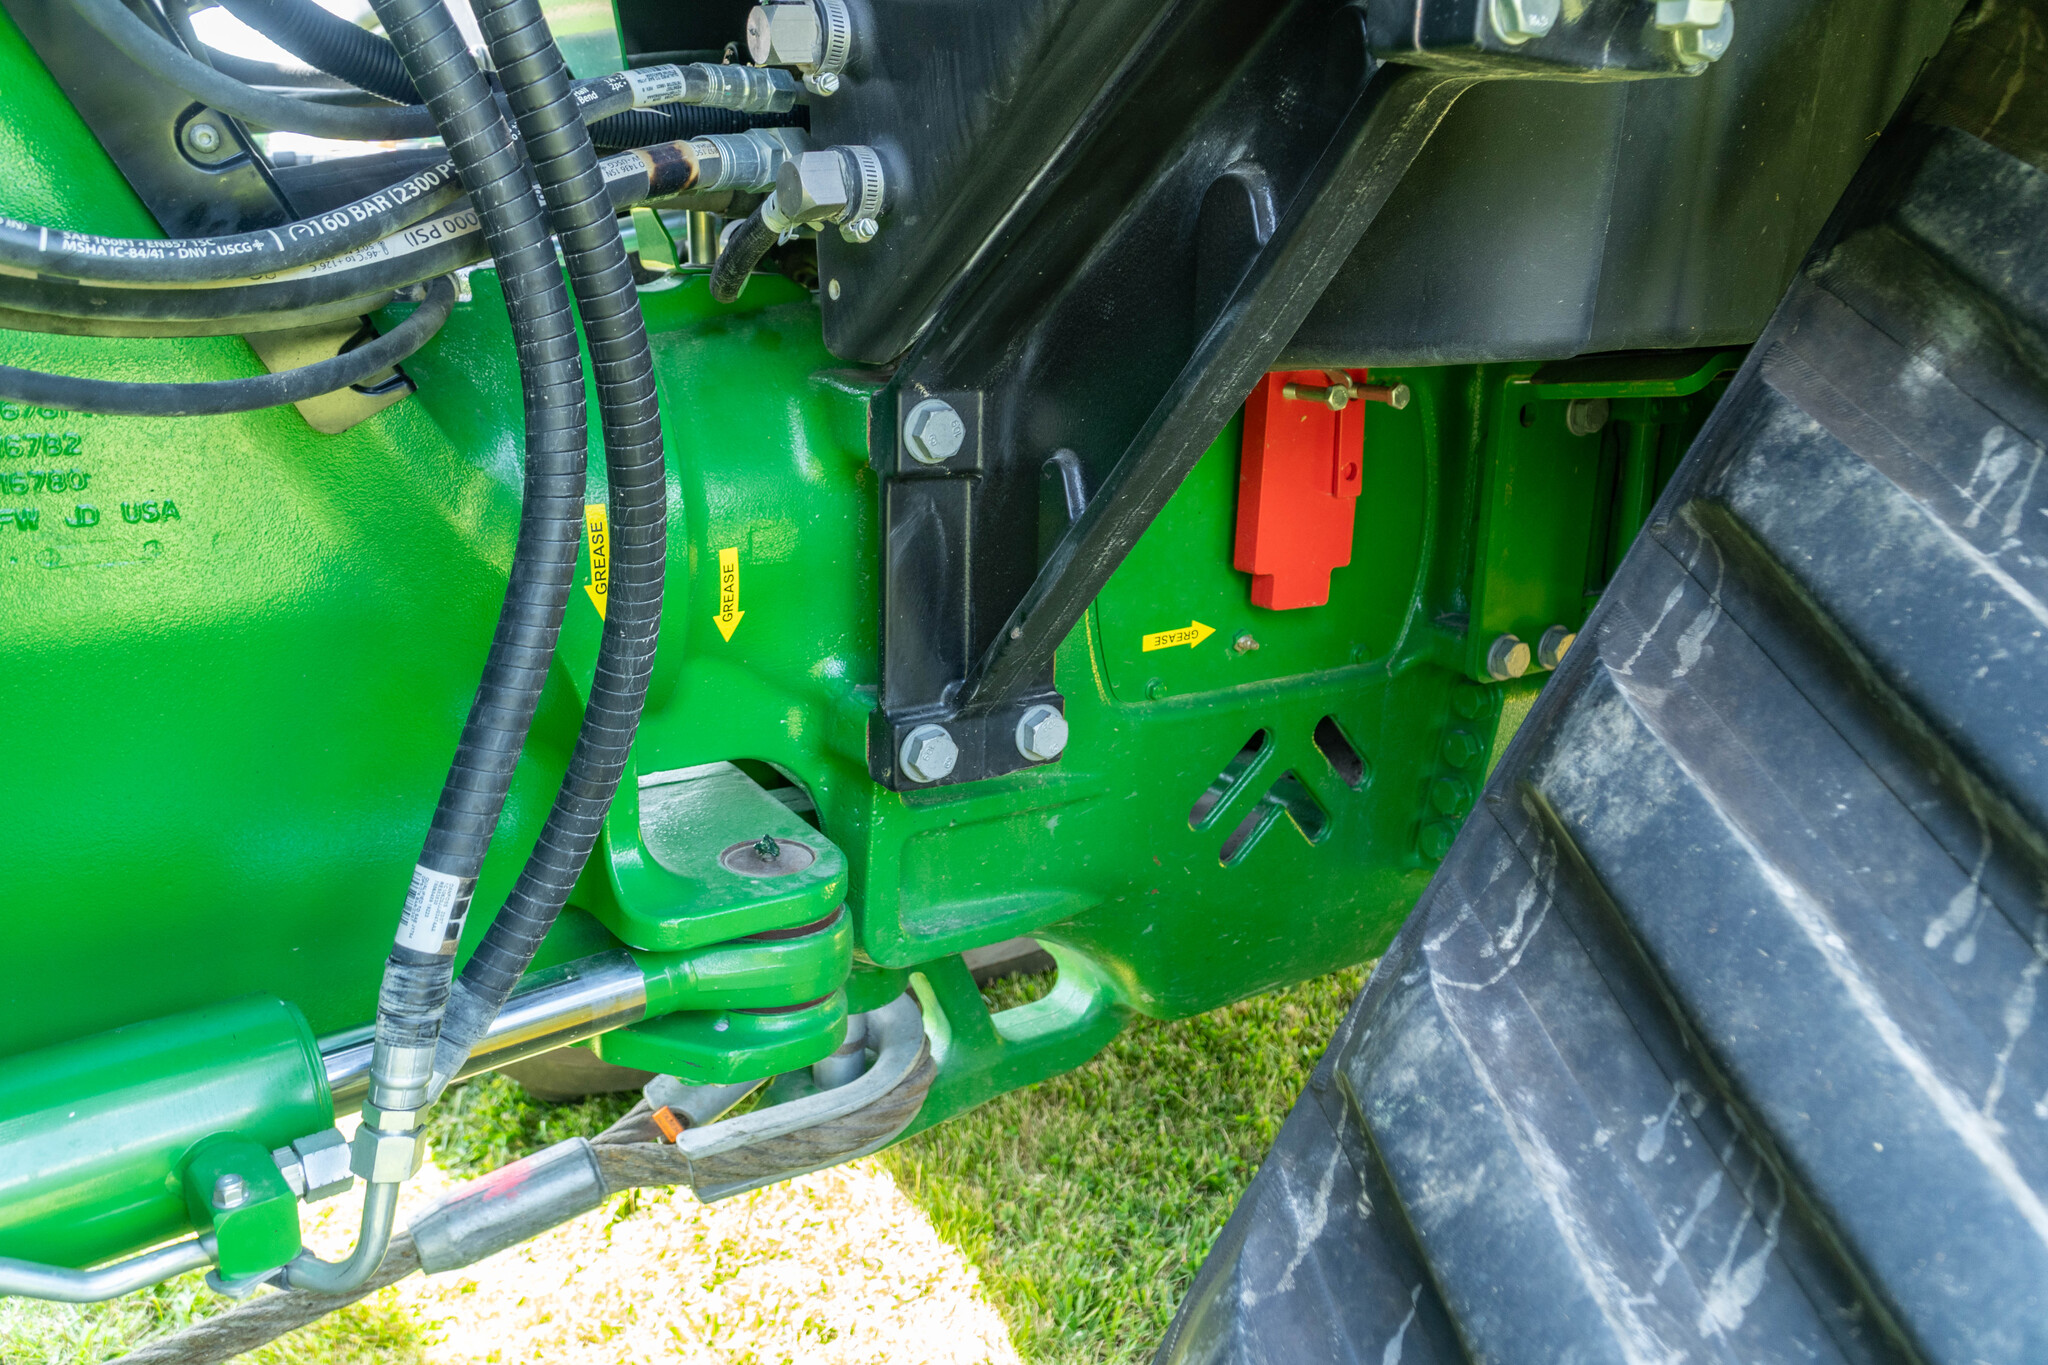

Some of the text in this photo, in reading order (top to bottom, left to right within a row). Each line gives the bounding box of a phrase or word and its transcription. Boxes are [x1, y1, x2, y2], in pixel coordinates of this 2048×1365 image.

[576, 90, 599, 105] Bend
[605, 168, 620, 178] 1SN
[607, 159, 628, 169] USCG
[620, 163, 638, 172] 1436
[309, 211, 350, 235] 160
[347, 194, 393, 222] BAR
[388, 171, 440, 205] (2300
[62, 230, 91, 243] SAE
[403, 223, 442, 247] PSI)
[61, 240, 253, 260] MSHA IC-84/41 DNV USCG
[65, 503, 101, 528] JD
[120, 498, 181, 525] USA
[590, 521, 607, 595] GREASE
[722, 563, 735, 623] GREASE
[1154, 629, 1199, 647] GREASE
